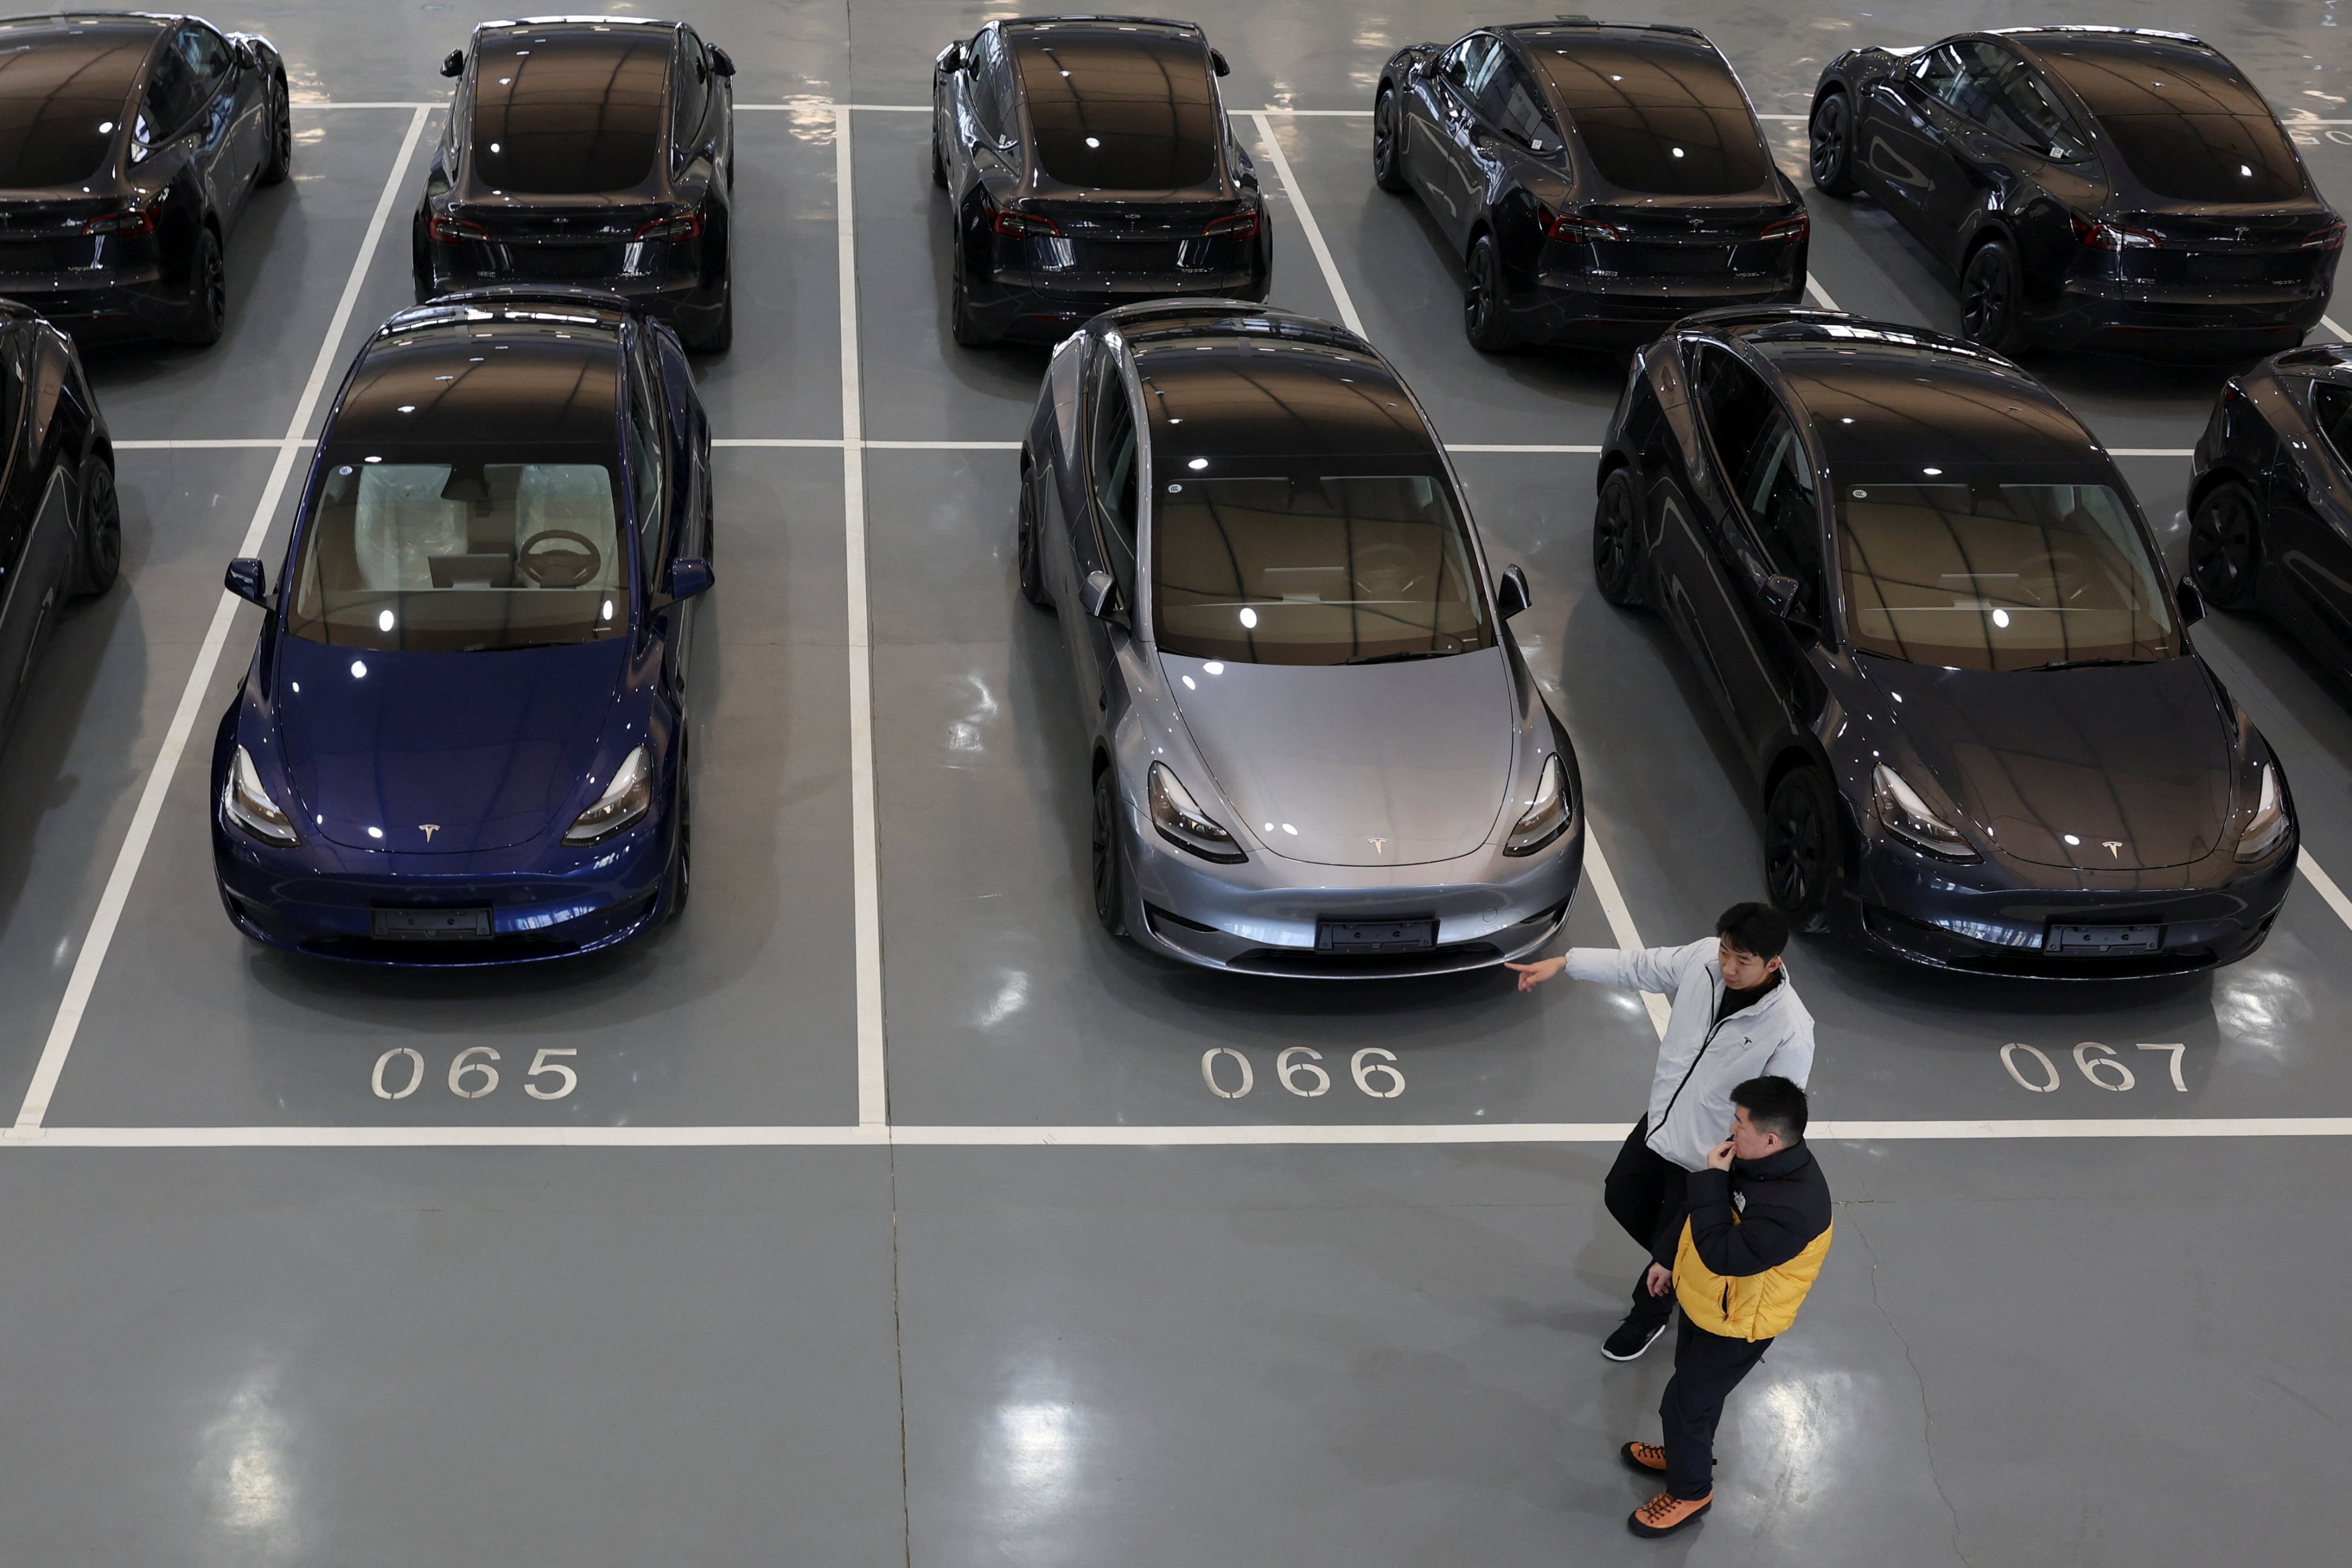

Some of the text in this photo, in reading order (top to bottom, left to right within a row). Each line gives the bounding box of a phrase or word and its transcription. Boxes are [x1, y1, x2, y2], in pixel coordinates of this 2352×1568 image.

[372, 1048, 577, 1099] 065
[1202, 1047, 1405, 1099] 066
[2000, 1044, 2188, 1092] 067
